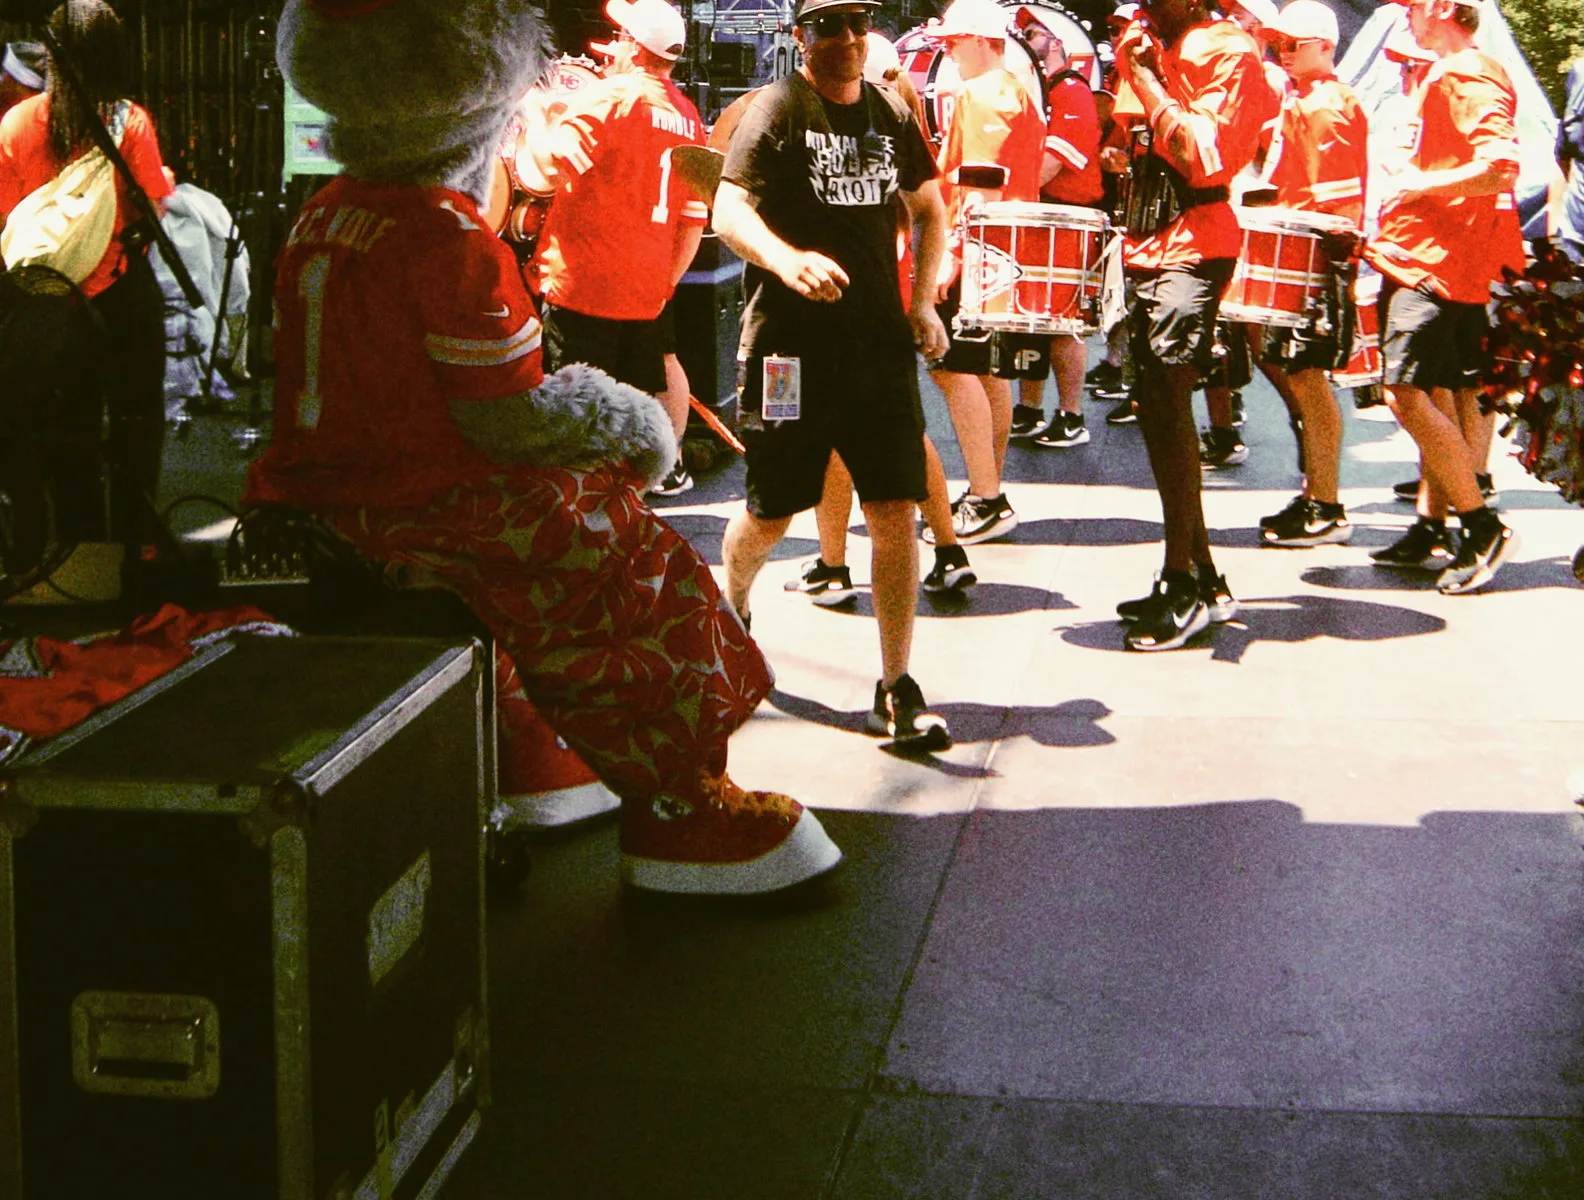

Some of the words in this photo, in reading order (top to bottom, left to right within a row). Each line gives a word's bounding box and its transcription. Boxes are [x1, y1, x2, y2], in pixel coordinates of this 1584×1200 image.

[651, 147, 673, 224] 1
[826, 180, 877, 203] RIOT
[297, 253, 331, 428] 1
